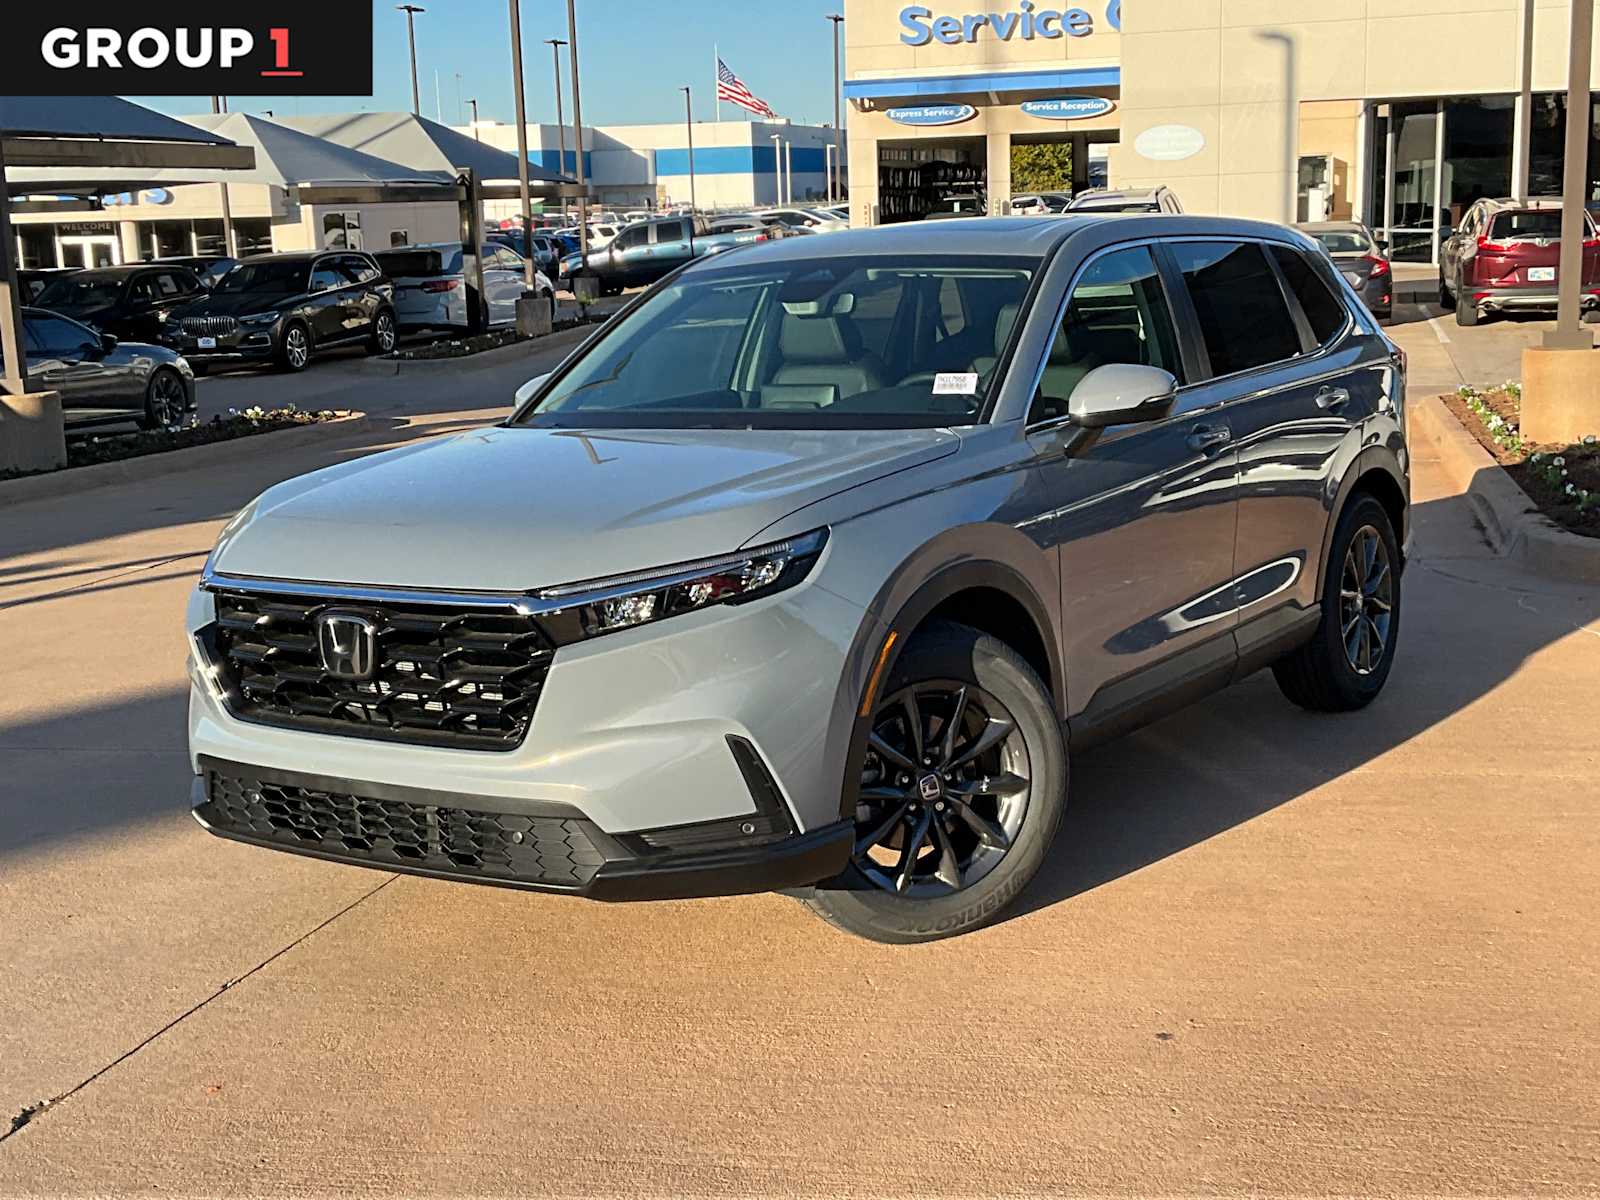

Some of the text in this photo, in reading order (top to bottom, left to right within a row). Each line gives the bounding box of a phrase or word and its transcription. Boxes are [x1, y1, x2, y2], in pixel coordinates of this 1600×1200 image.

[899, 0, 1093, 46] Service
[1025, 100, 1105, 112] Service Reception
[890, 108, 955, 119] Express Service
[61, 222, 112, 231] WELCOME
